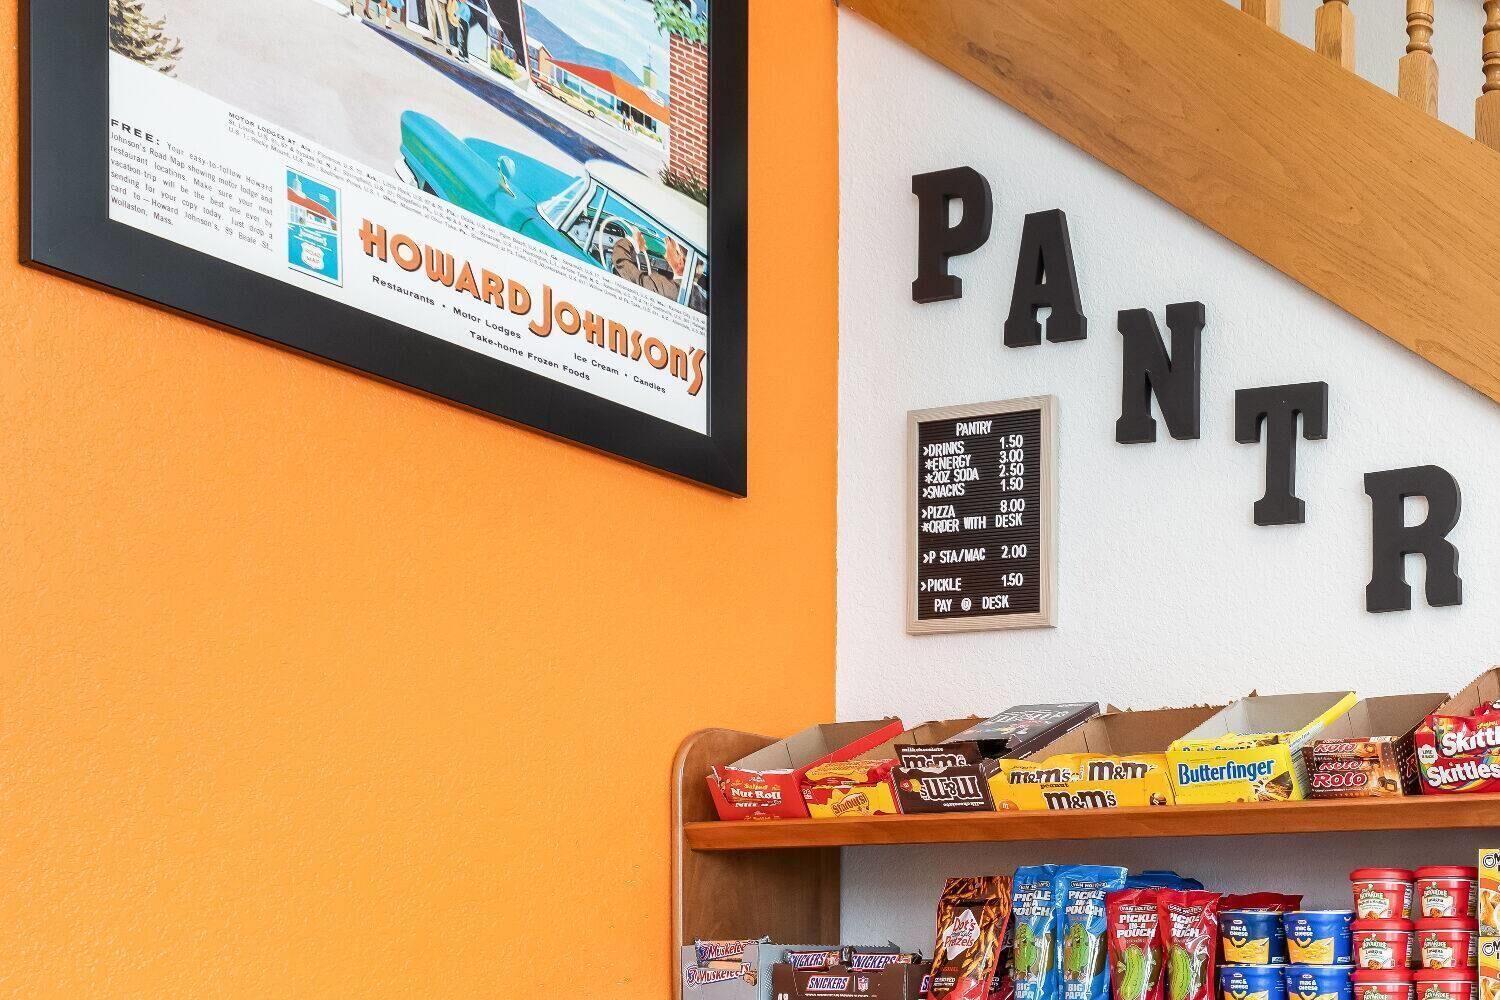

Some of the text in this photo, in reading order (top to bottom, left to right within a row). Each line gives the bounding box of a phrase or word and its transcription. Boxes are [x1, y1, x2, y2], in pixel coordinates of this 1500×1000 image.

[111, 118, 160, 146] FREE:
[359, 217, 532, 315] HOWARD
[372, 275, 522, 340] Restaurants Motor Lodges
[470, 330, 591, 382] Take-home Frozen Foods
[574, 352, 666, 394] Ice Cream Candies
[956, 420, 993, 437] PANTRY
[999, 434, 1024, 449] 1.50
[999, 449, 1024, 464] 3.00
[954, 467, 979, 483] SODA
[998, 463, 1025, 478] 2.50
[1000, 476, 1024, 491] 1.50
[1000, 498, 1026, 513] 8.00
[963, 515, 987, 530] WITH
[995, 513, 1023, 528] DESK
[939, 547, 986, 564] STA/MAC
[1001, 543, 1027, 559] 2.00
[1001, 572, 1024, 587] 1.50
[934, 598, 953, 613] PAY
[982, 594, 1009, 610] DESK
[1178, 759, 1275, 786] Butterfinger
[1313, 772, 1368, 787] Rolo
[730, 787, 782, 800] Nut Roll
[1043, 790, 1116, 810] m&m's
[1012, 890, 1052, 902] PICKLE
[1068, 890, 1107, 901] PICKLE
[1012, 907, 1051, 916] POUCH
[1065, 905, 1106, 917] POUCH
[1119, 913, 1158, 924] PICKLE
[953, 917, 976, 932] Dot's
[1116, 928, 1156, 939] POUCH
[944, 936, 975, 948] Pretzels
[808, 976, 849, 991] SNICKERS
[1016, 983, 1030, 991] BIG
[1068, 983, 1084, 991] BIG
